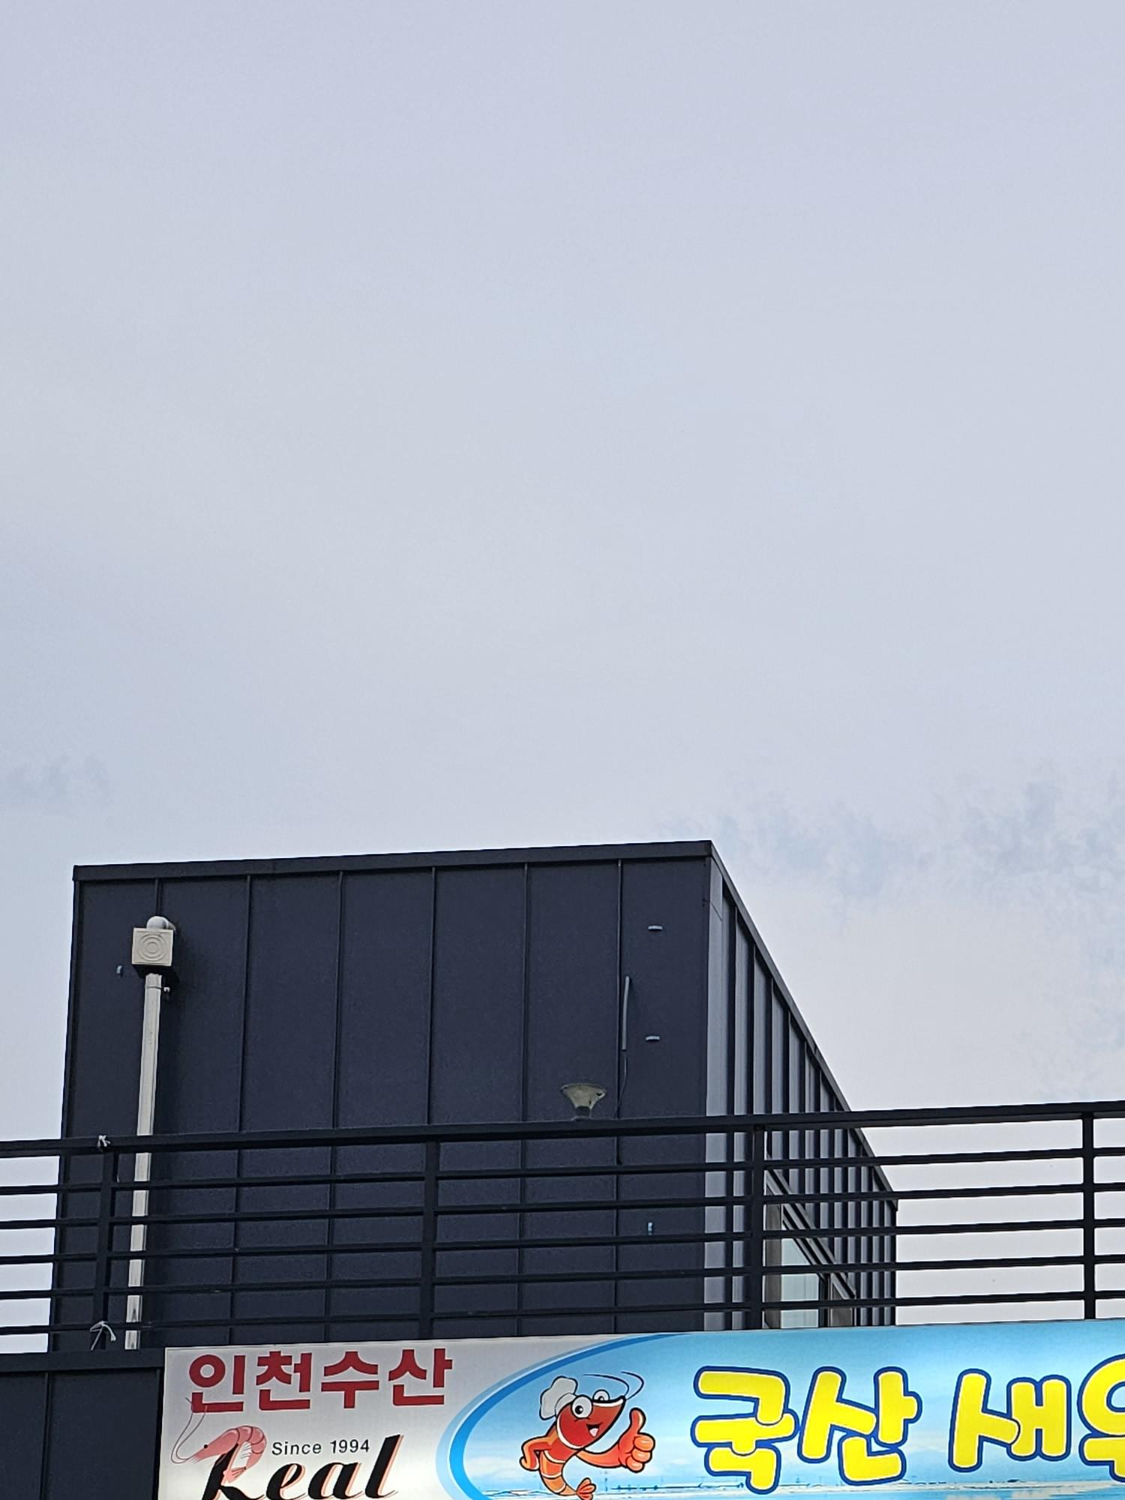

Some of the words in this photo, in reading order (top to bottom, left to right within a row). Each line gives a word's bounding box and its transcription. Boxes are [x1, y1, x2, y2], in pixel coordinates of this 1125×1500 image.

[188, 1348, 453, 1413] 인천수산
[271, 1441, 322, 1456] Since
[330, 1439, 370, 1455] 1994
[691, 1365, 922, 1494] 국산
